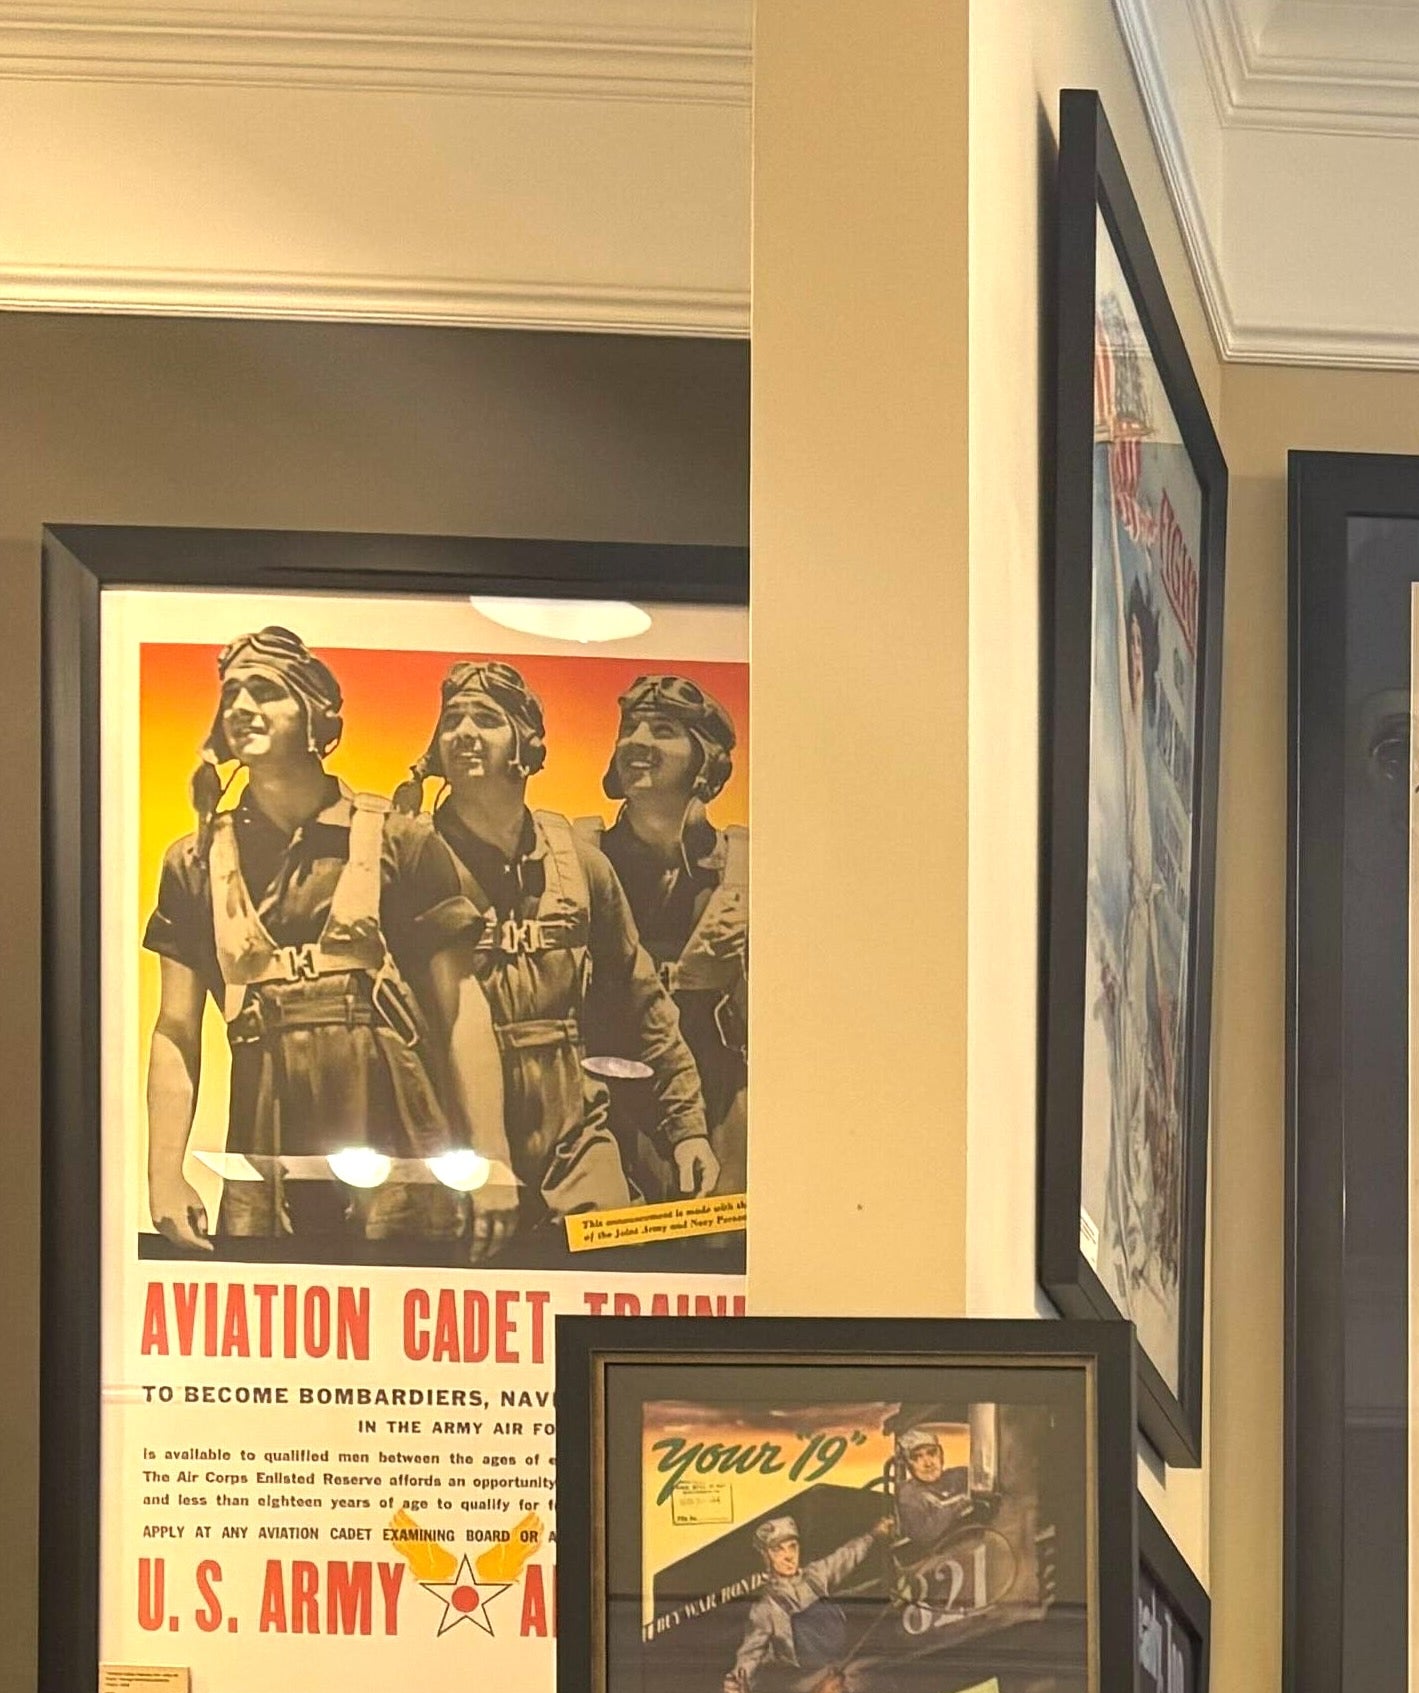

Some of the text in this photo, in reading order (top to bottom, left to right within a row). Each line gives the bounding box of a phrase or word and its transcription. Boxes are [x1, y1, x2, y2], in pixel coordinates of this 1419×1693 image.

[141, 1282, 550, 1363] AVIATION CADET
[143, 1386, 489, 1408] TO BECOME BOMBARDIERS,
[359, 1421, 523, 1435] IN THE ARMY AIR
[165, 1449, 539, 1467] available to qualified men between the ages of
[143, 1471, 556, 1490] The Air Corps Enlisted Reserve affords an opportunity
[652, 1438, 786, 1505] Your
[143, 1494, 539, 1512] and less than eighteen years of age to qualify for
[143, 1526, 538, 1542] APPLY AT ANY AVIATION CADET EXAMINING BOARD OR
[138, 1557, 405, 1635] U. S. ARMY
[657, 1572, 770, 1632] BUY WAR BONDS
